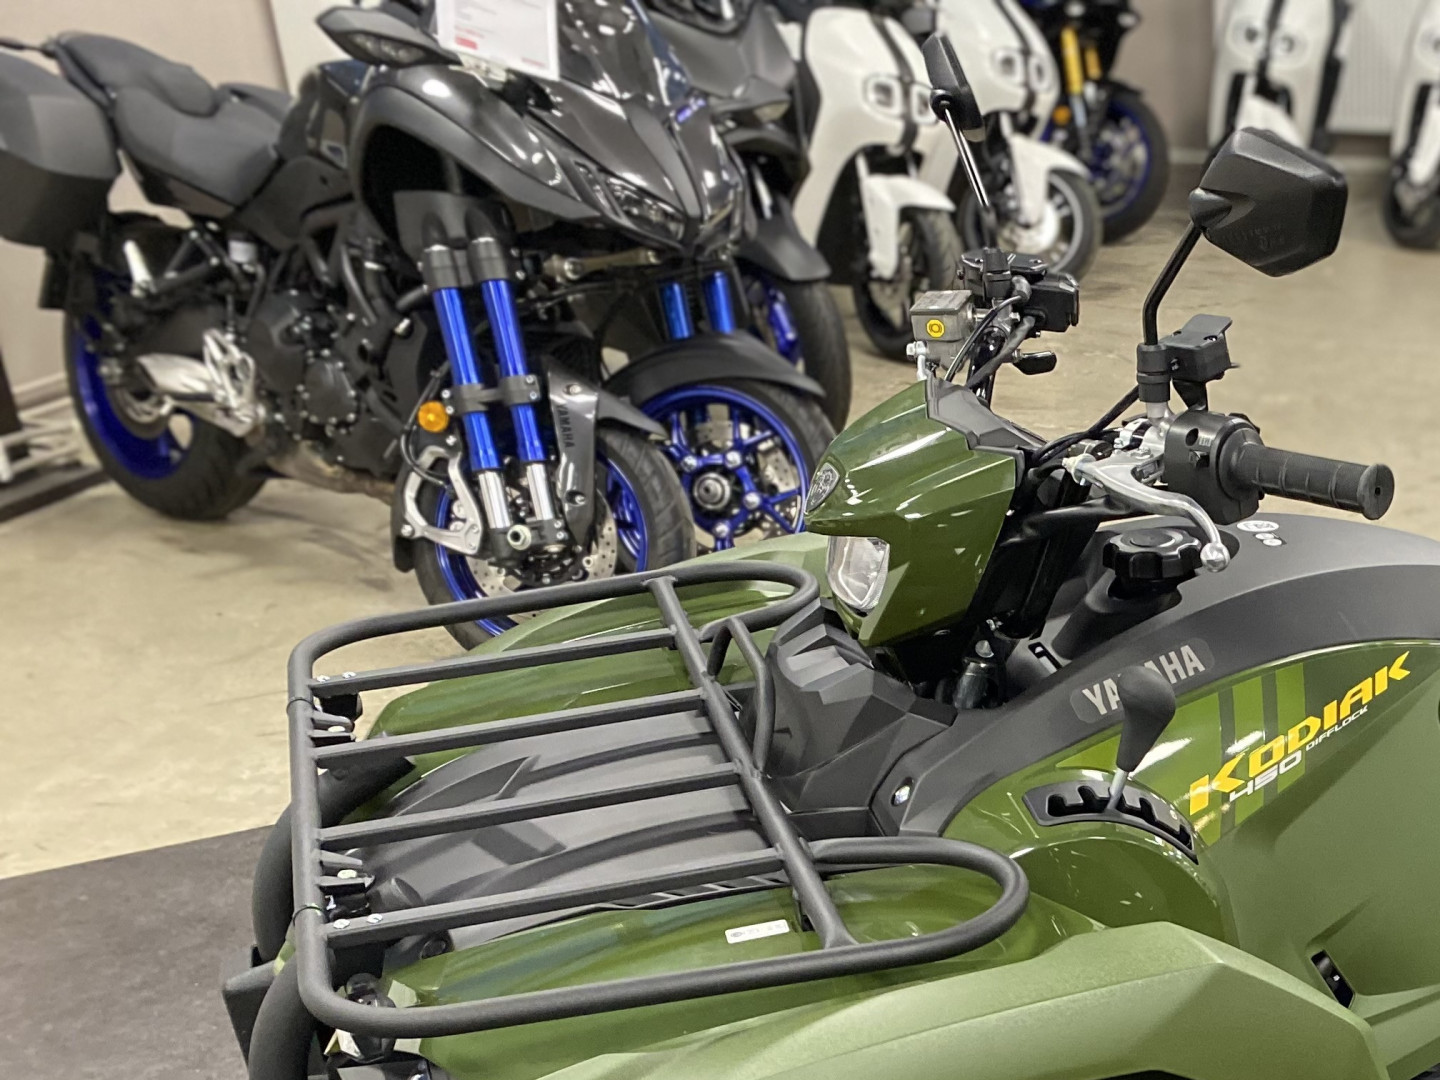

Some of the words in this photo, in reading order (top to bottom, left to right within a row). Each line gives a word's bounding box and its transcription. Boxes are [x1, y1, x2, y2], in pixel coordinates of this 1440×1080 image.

[1081, 644, 1206, 716] YAHA
[1189, 650, 1411, 816] KODIAK
[1229, 749, 1302, 803] 450
[1305, 704, 1369, 752] DIFFLOCK
